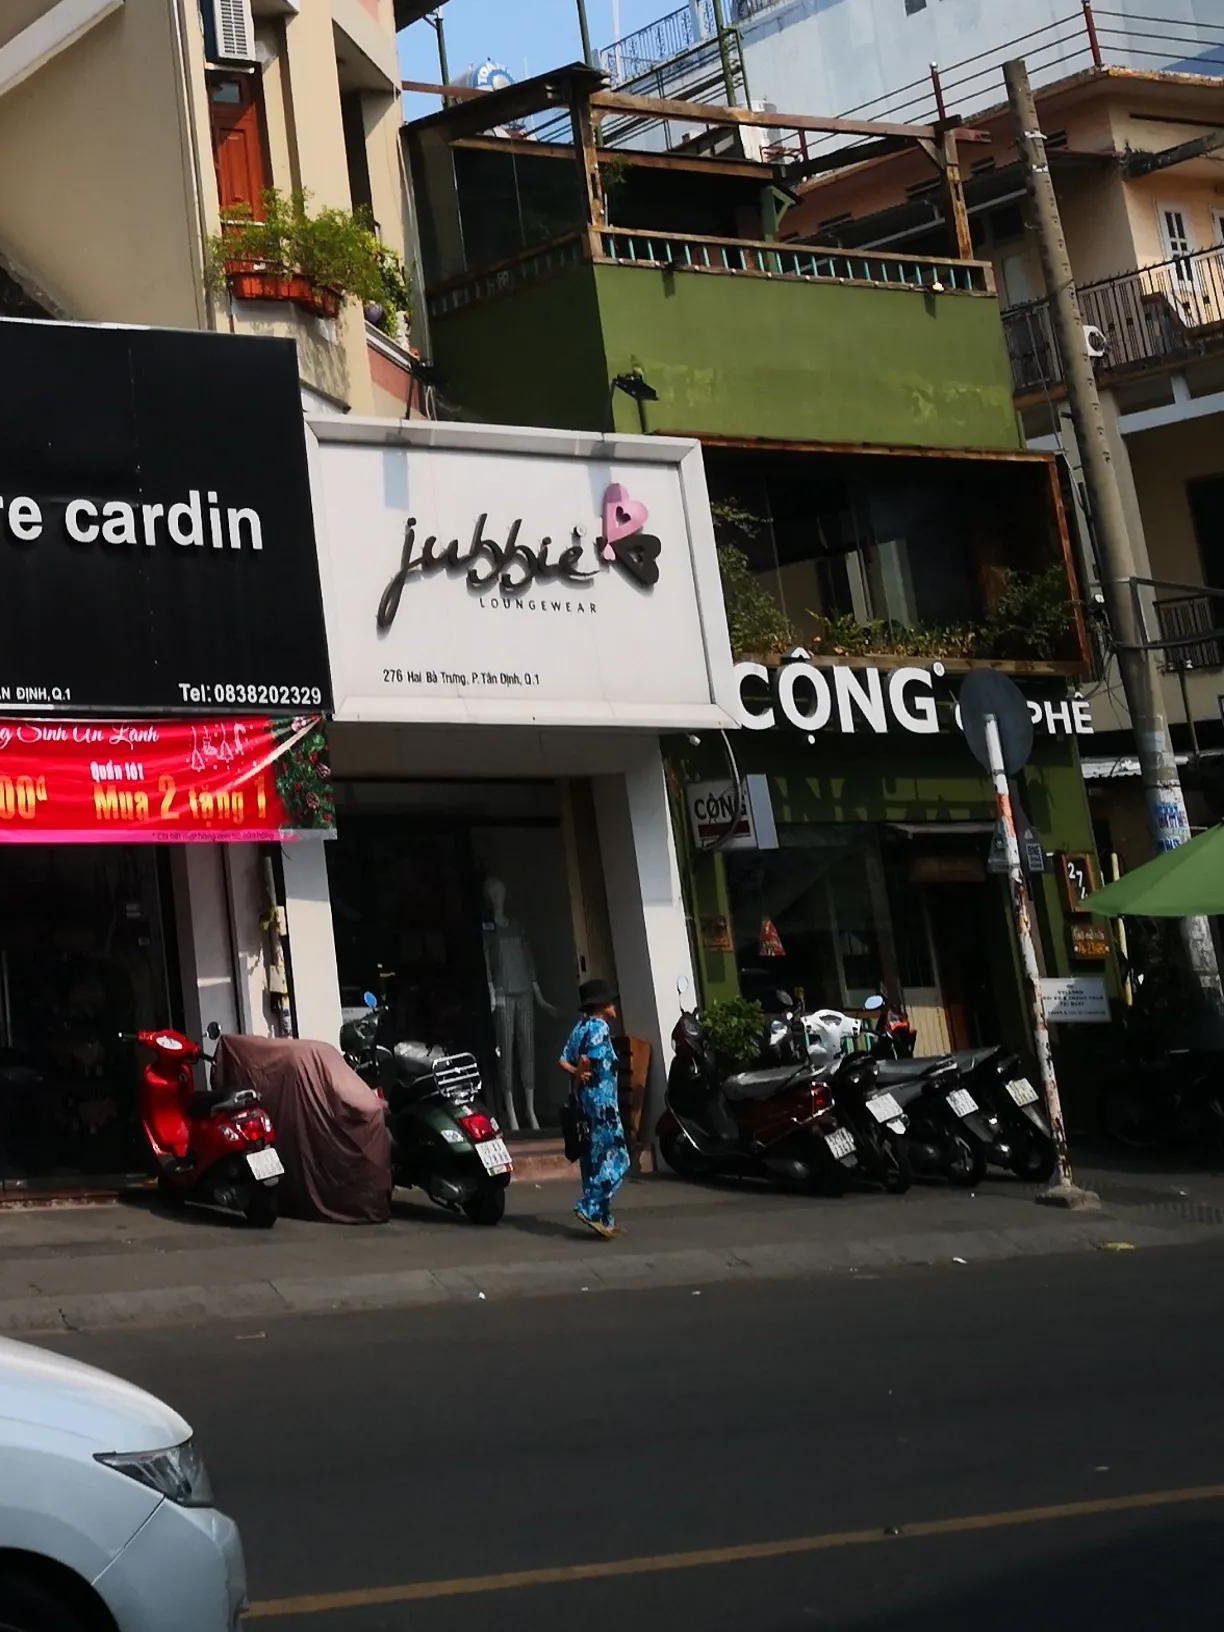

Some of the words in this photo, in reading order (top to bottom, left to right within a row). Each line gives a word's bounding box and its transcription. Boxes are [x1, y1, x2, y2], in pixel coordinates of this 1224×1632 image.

[64, 488, 264, 551] cardin
[376, 512, 601, 629] jubbie
[479, 597, 598, 615] LOUNGEWEAR
[382, 668, 403, 683] 276
[735, 646, 940, 745] CỘNG
[93, 782, 149, 821] Mua
[158, 775, 180, 820] 2
[253, 775, 267, 819] 1
